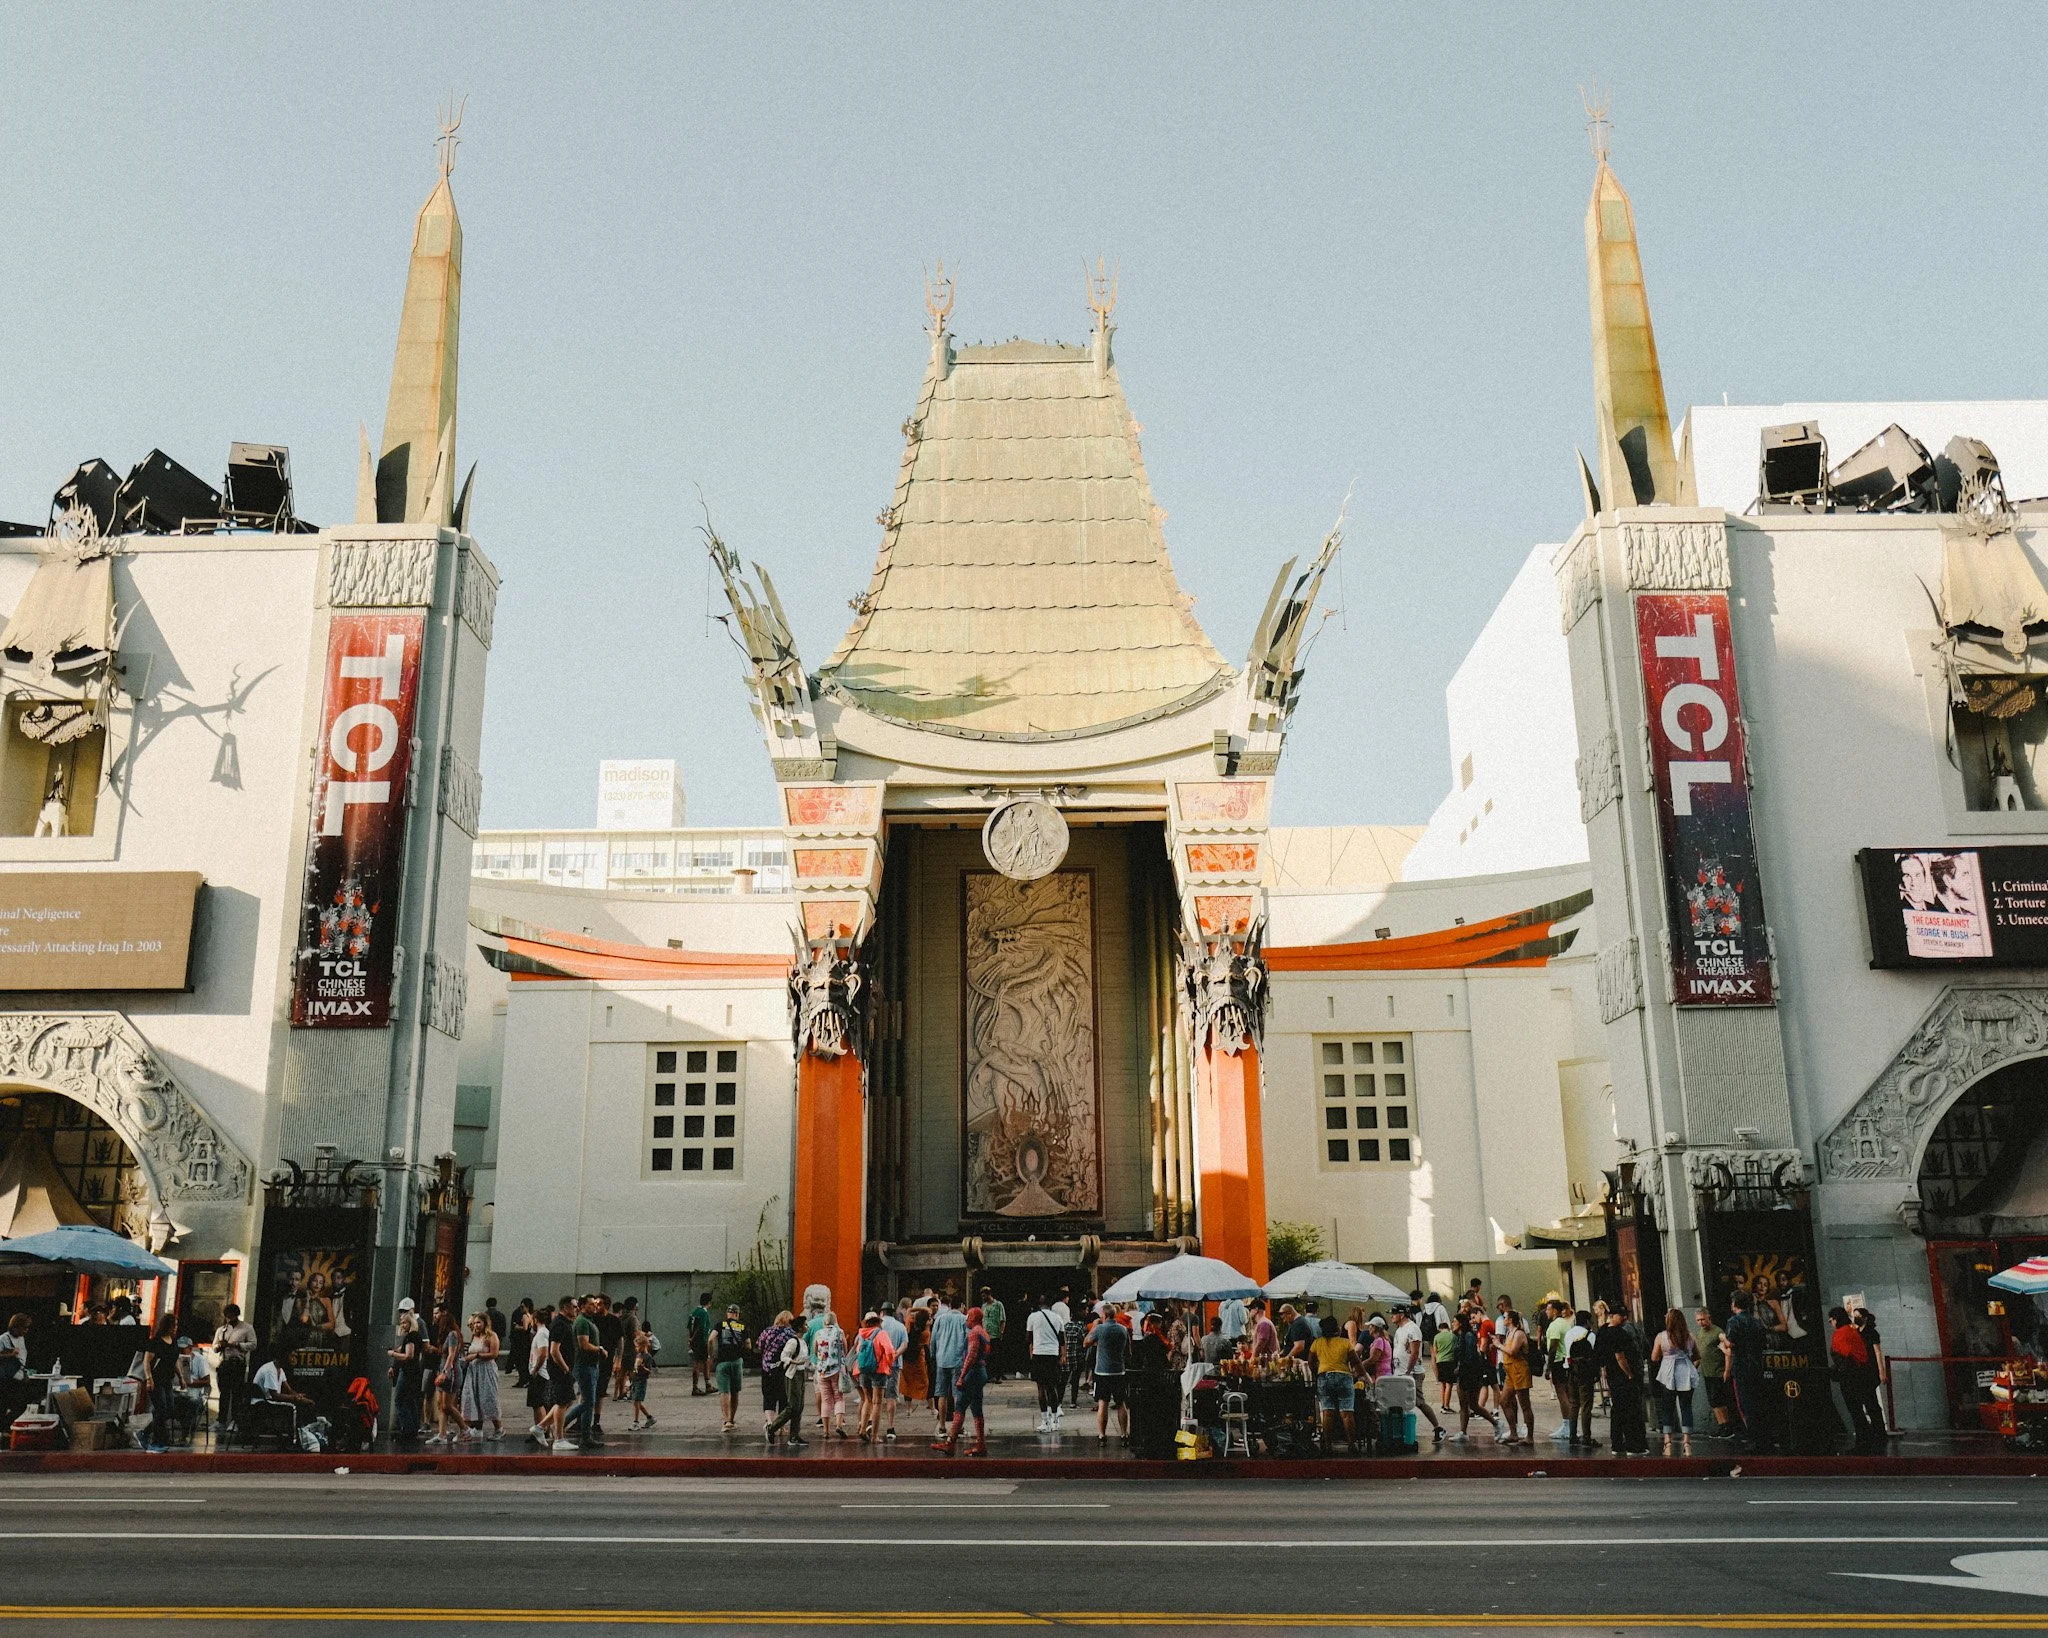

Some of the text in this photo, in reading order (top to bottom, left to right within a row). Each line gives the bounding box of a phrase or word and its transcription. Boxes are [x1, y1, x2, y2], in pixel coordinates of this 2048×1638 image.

[1655, 614, 1732, 816] TCL
[322, 634, 405, 836] TCL
[604, 766, 669, 782] madison
[1991, 881, 2001, 892] 1.
[1993, 897, 2046, 909] 2. Torture
[23, 908, 81, 922] Negligence
[1996, 914, 2006, 925] 3.
[1912, 916, 1970, 929] THE CASE AGAINST
[1916, 927, 1940, 937] GEORGE
[1950, 929, 1969, 940] BUSH
[43, 942, 95, 955] Attacking
[98, 942, 119, 955] Iraq
[122, 941, 134, 952] In
[136, 941, 162, 952] 2003
[1694, 939, 1744, 956] TCL
[319, 960, 367, 977] TCL
[1696, 957, 1744, 967] CHINESE
[1696, 966, 1746, 976] THEATRES
[317, 978, 366, 989] CHINESE
[1689, 979, 1756, 994] IMAX
[317, 987, 366, 997] THEATRES
[307, 1001, 372, 1016] IMAX
